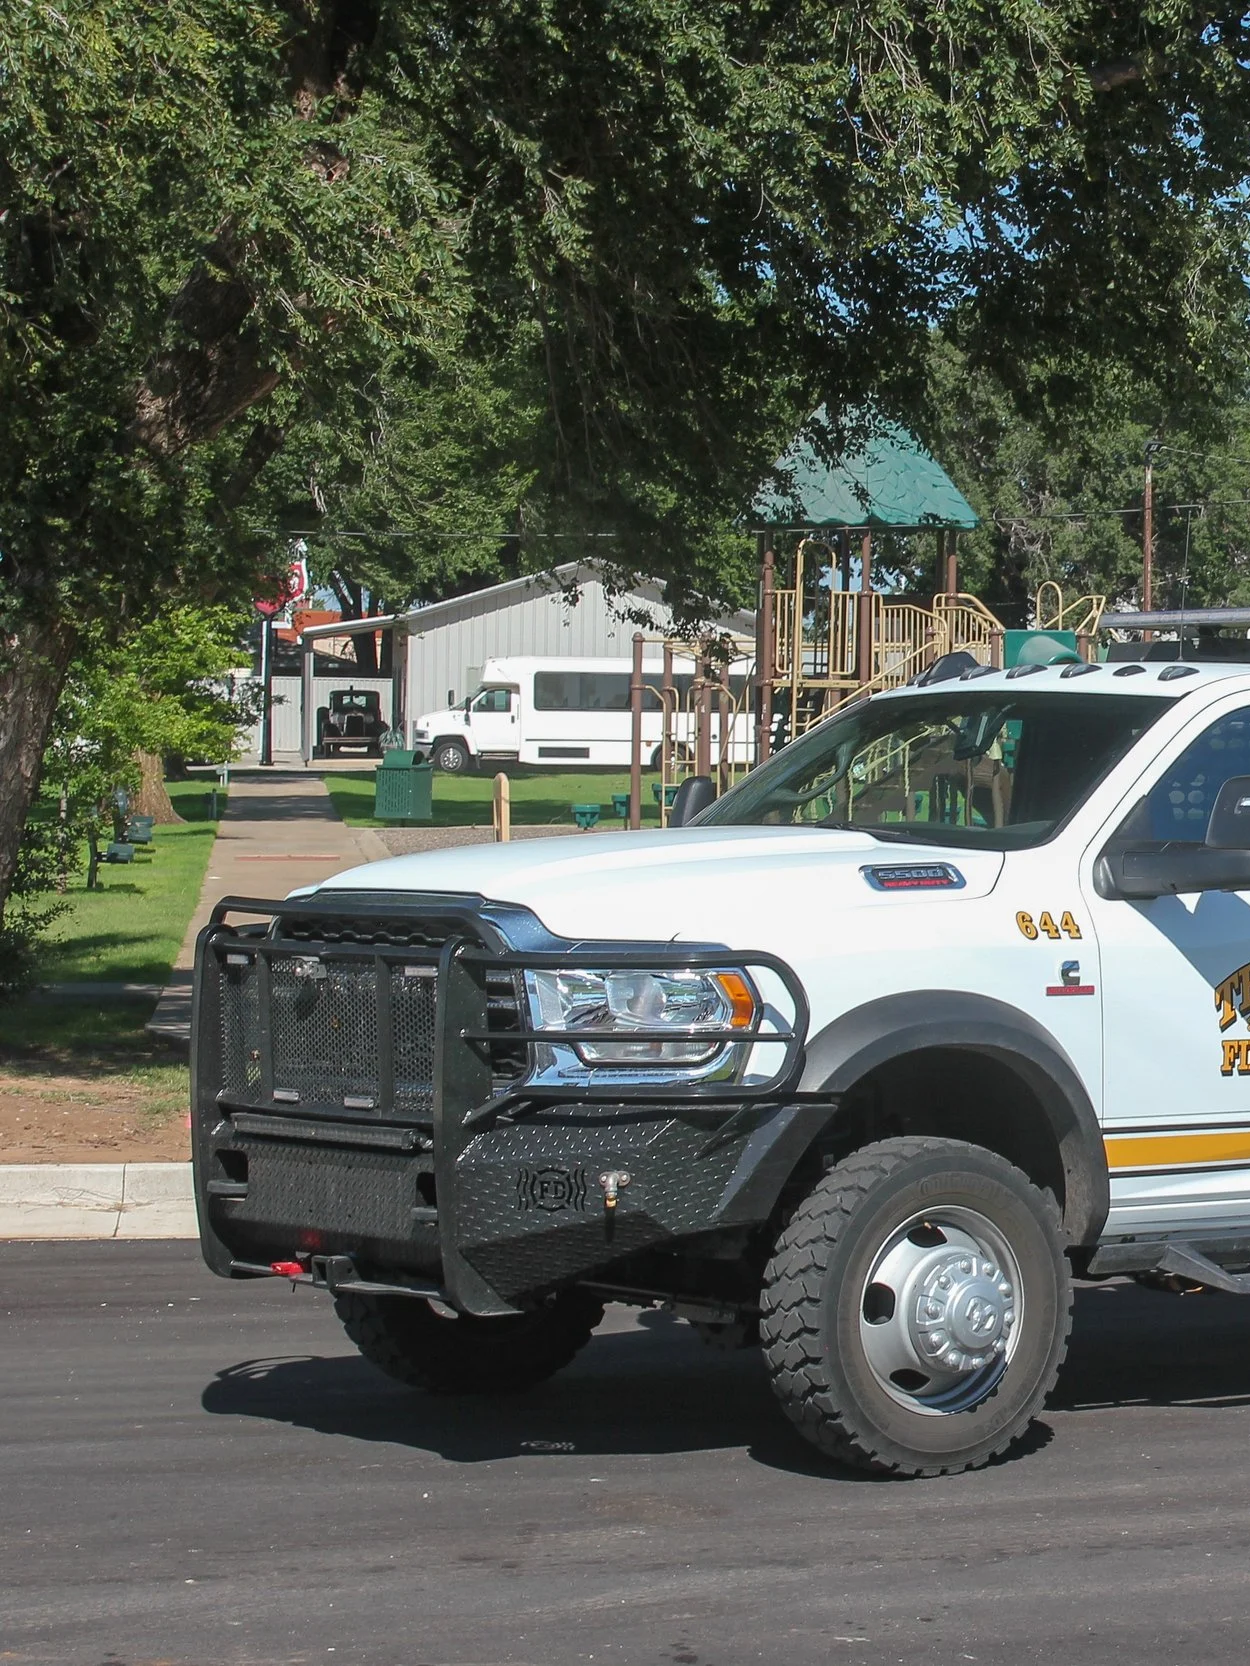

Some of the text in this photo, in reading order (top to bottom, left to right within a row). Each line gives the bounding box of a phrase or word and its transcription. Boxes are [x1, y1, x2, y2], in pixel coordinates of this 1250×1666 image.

[878, 869, 944, 879] 5500
[1015, 910, 1082, 940] 644
[539, 1180, 566, 1200] FD
